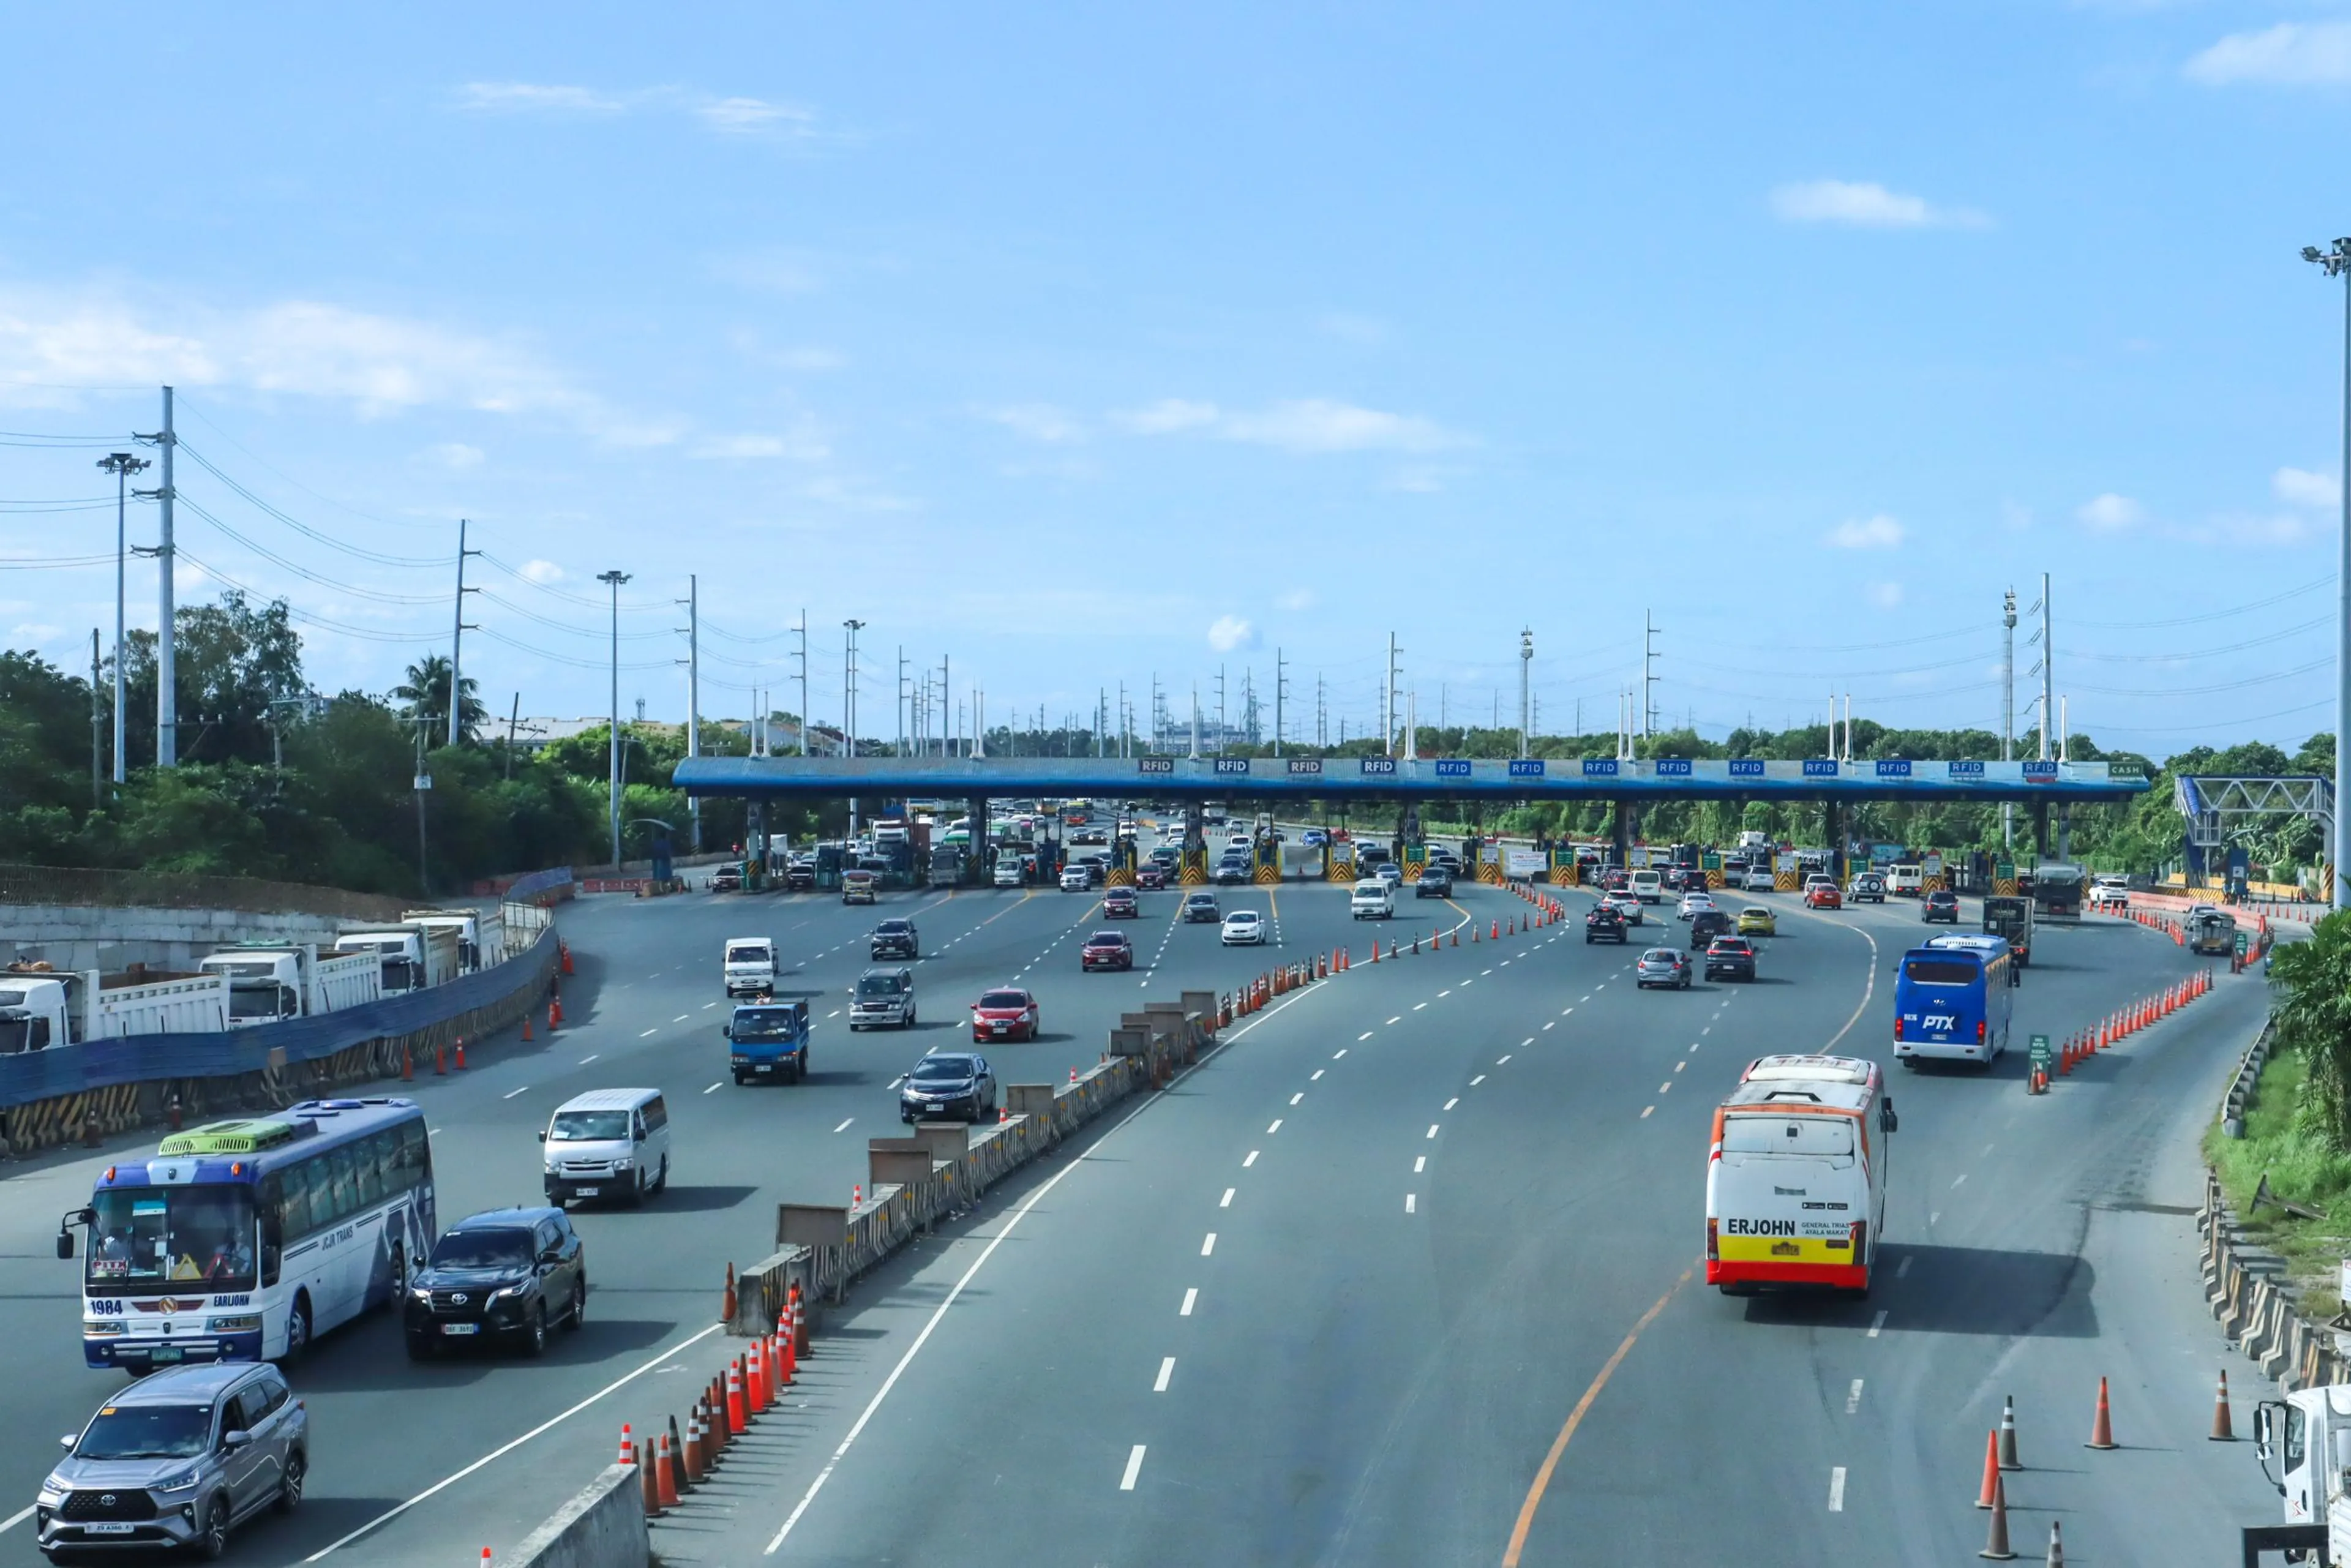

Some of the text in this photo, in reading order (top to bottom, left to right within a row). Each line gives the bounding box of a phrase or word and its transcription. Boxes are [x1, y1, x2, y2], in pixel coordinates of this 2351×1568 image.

[1142, 761, 1171, 771] RFID
[1218, 761, 1247, 771] RFID
[1291, 762, 1319, 771] RFID
[1365, 761, 1393, 771] RFID
[1439, 763, 1468, 773] RFID
[1513, 763, 1541, 773] RFID
[1586, 763, 1614, 772] RFID
[1660, 763, 1688, 772] RFID
[1733, 763, 1761, 772] RFID
[1806, 763, 1834, 772] RFID
[1880, 763, 1908, 773] RFID
[1952, 763, 1981, 771] RFID
[1922, 1015, 1955, 1030] PTX
[1728, 1218, 1795, 1236] ERJOHN
[91, 1300, 122, 1315] 1984
